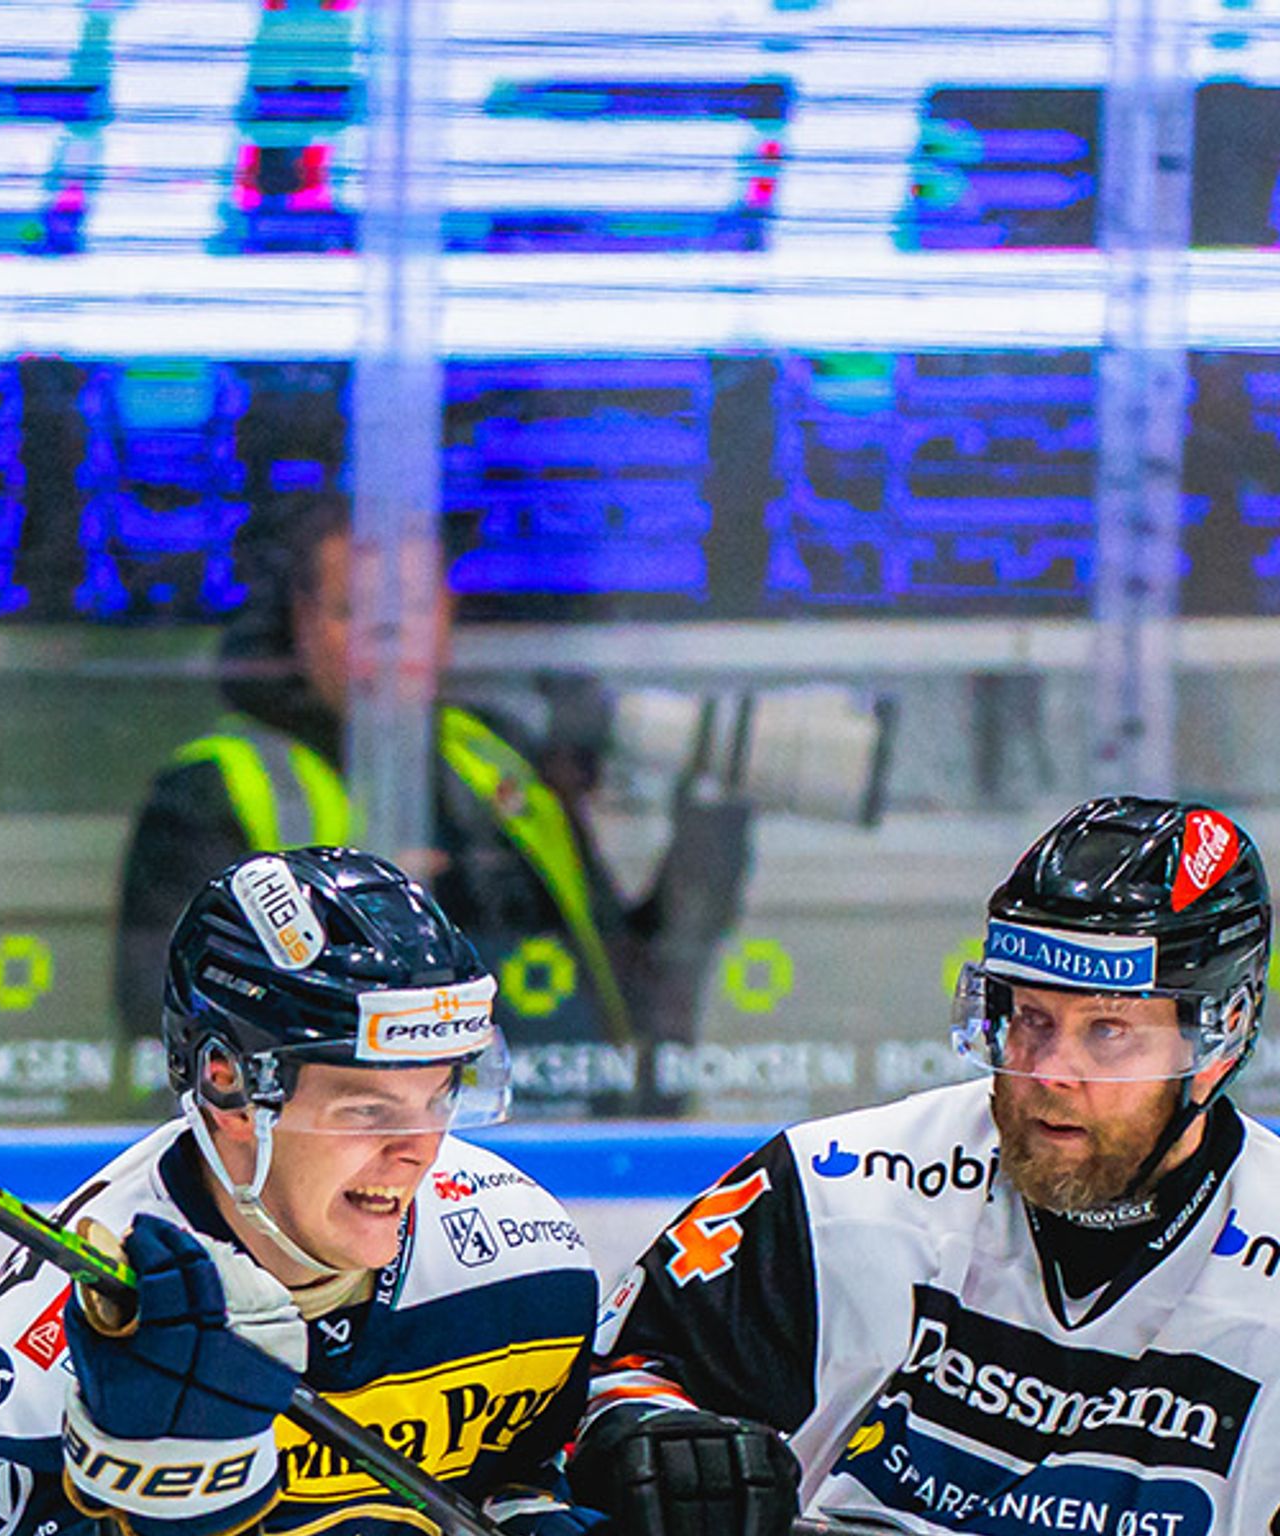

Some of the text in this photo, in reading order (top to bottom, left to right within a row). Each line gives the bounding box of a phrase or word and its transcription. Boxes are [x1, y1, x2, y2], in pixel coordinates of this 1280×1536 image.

[990, 931, 1135, 980] POLARBAD
[863, 1144, 1000, 1202] mobi
[902, 1317, 1220, 1451] Dessmann
[882, 1444, 1110, 1536] SPARENKEN
